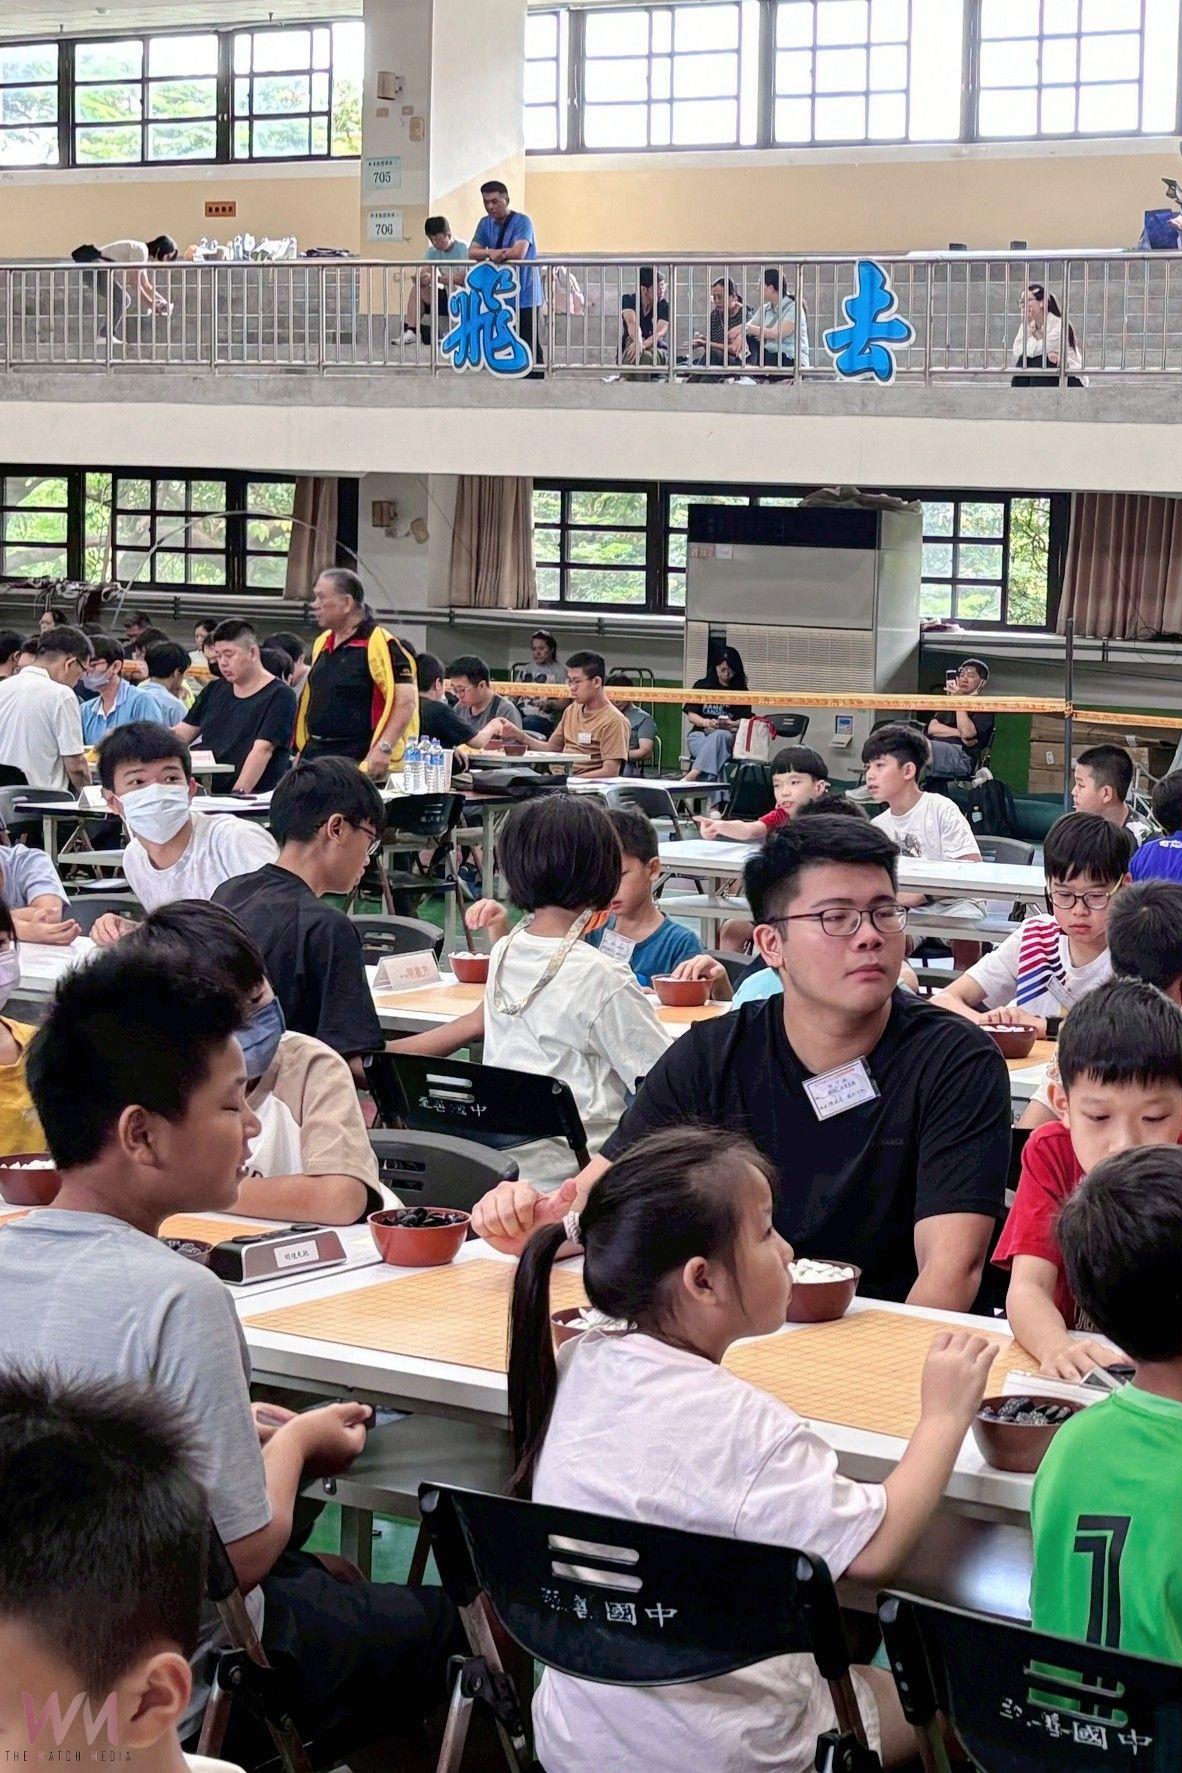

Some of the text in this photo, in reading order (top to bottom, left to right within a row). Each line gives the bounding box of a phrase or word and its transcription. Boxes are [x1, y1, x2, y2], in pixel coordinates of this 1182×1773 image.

[373, 171, 391, 183] 705
[375, 224, 393, 235] 706
[442, 262, 532, 376] 飛
[824, 259, 914, 384] 去
[541, 1586, 678, 1628] 善國中
